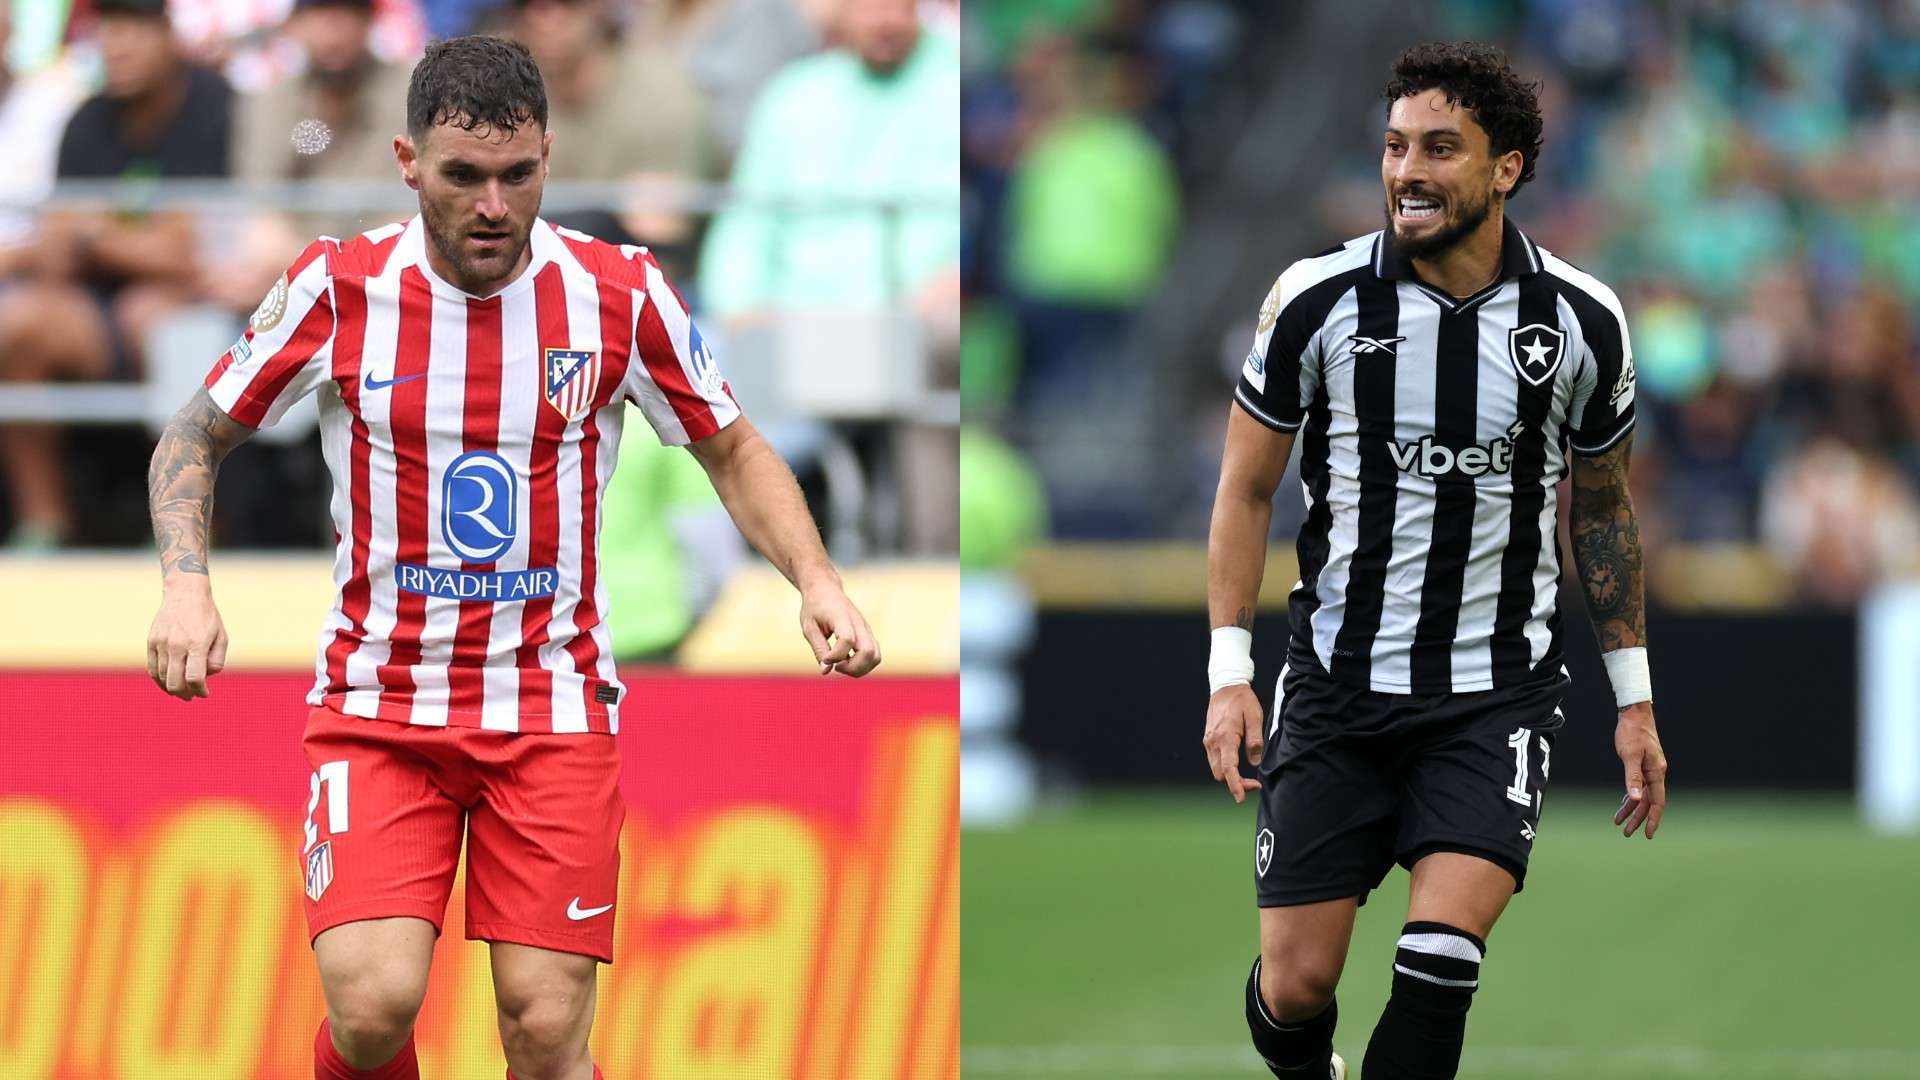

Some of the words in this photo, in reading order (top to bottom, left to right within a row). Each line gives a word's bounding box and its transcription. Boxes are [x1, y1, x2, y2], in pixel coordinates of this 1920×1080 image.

[1386, 437, 1510, 475] vbet
[446, 455, 516, 559] R
[402, 566, 502, 598] RIYADH
[510, 571, 553, 598] AIR
